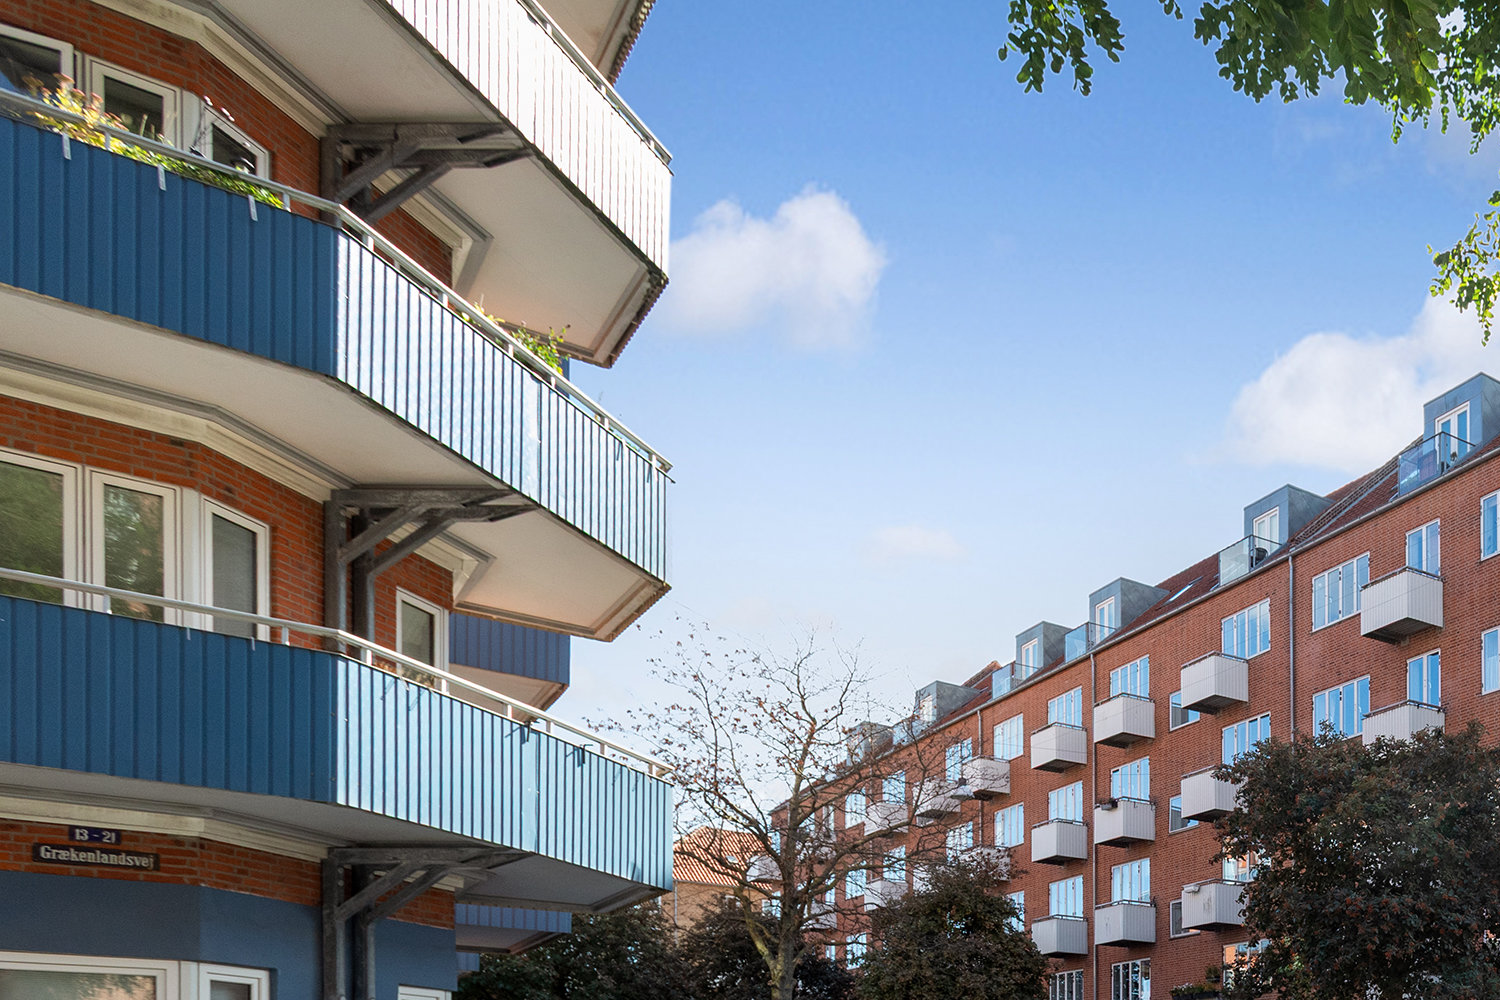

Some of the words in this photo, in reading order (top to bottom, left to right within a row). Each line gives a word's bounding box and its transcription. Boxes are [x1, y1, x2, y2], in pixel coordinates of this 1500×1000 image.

[74, 828, 89, 840] 13
[102, 831, 116, 843] 21
[40, 846, 155, 870] Grækenlandsvej
